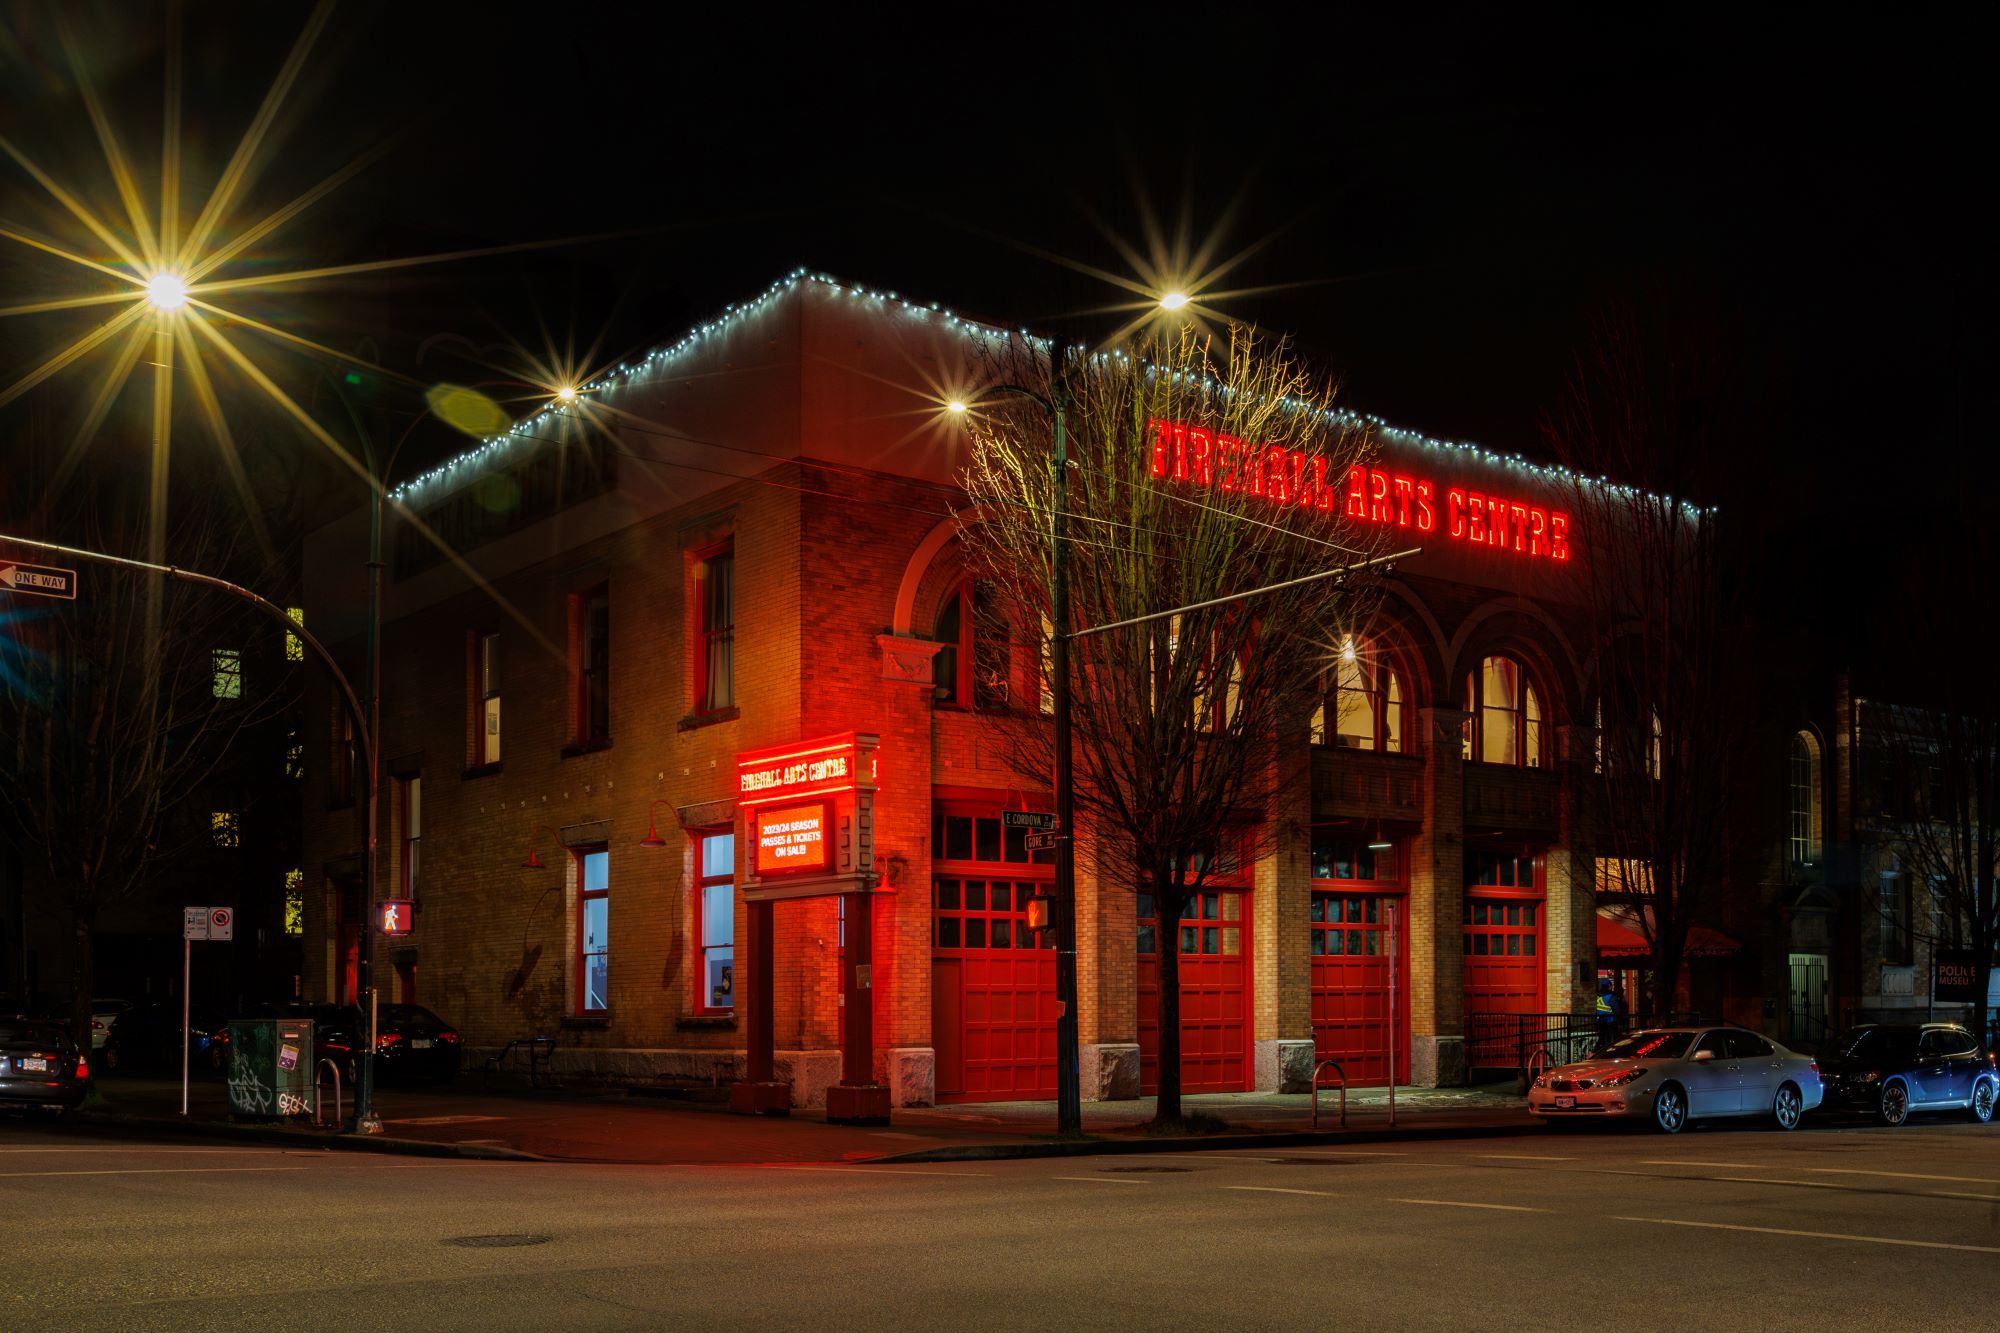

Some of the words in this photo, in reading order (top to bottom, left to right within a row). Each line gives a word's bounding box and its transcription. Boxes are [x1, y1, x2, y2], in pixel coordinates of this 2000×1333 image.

[1348, 465, 1436, 532] ARTS
[1448, 487, 1569, 562] CENTRE
[15, 572, 37, 584] ONE
[41, 576, 64, 588] WAY
[741, 769, 782, 791] FIREHALL
[784, 763, 807, 785] ARTS
[809, 757, 847, 781] CENTRE
[763, 823, 789, 835] 2023/24
[790, 819, 819, 832] SEASON
[761, 836, 785, 847] PASSES
[793, 831, 821, 843] TICKETS
[775, 848, 787, 858] ON
[788, 844, 806, 857] SALE!
